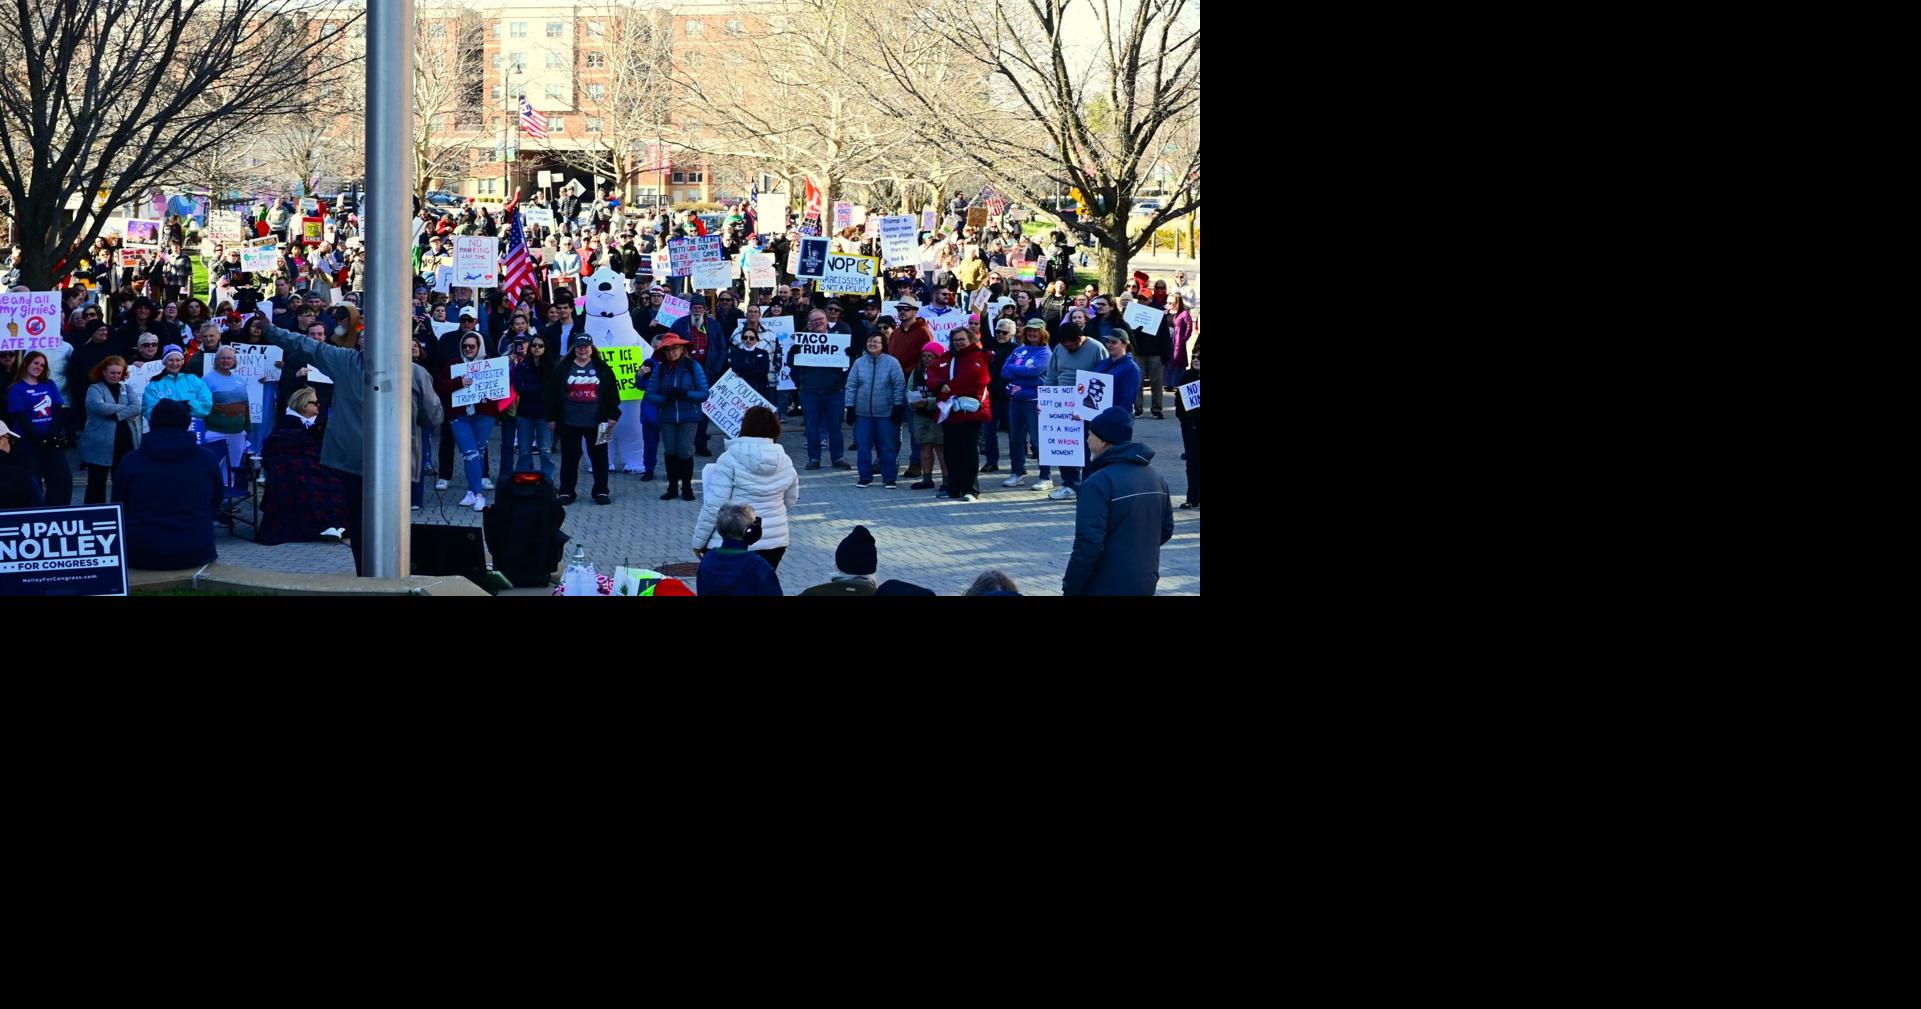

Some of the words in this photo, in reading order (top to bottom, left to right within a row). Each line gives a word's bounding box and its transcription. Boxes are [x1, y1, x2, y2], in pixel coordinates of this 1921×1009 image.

[845, 285, 870, 293] POLICY
[0, 296, 9, 304] e
[11, 294, 32, 304] and
[35, 295, 49, 304] all
[0, 305, 17, 317] my
[20, 304, 56, 318] girlies
[927, 320, 942, 331] No
[944, 321, 957, 330] one
[1, 338, 25, 349] ATE
[29, 337, 60, 349] ICE!
[796, 334, 828, 344] TACO
[601, 351, 615, 362] LT
[620, 349, 632, 361] ICE
[800, 344, 839, 355] TRUMP
[467, 362, 481, 371] NOT
[484, 361, 491, 369] A
[619, 363, 638, 374] THE
[475, 379, 499, 391] DESPISE
[716, 383, 733, 398] WANT
[734, 382, 751, 398] YOU
[1187, 384, 1198, 396] NO
[456, 393, 477, 404] TRUMP
[490, 387, 505, 398] FREE
[716, 396, 730, 411] THE
[713, 411, 735, 431] ELECT
[34, 520, 92, 537] PAUL
[0, 534, 116, 560] NOLLEY
[18, 562, 39, 570] FOR
[42, 559, 99, 569] CONGRESS
[22, 574, 97, 583] NolleyForCongress.com
